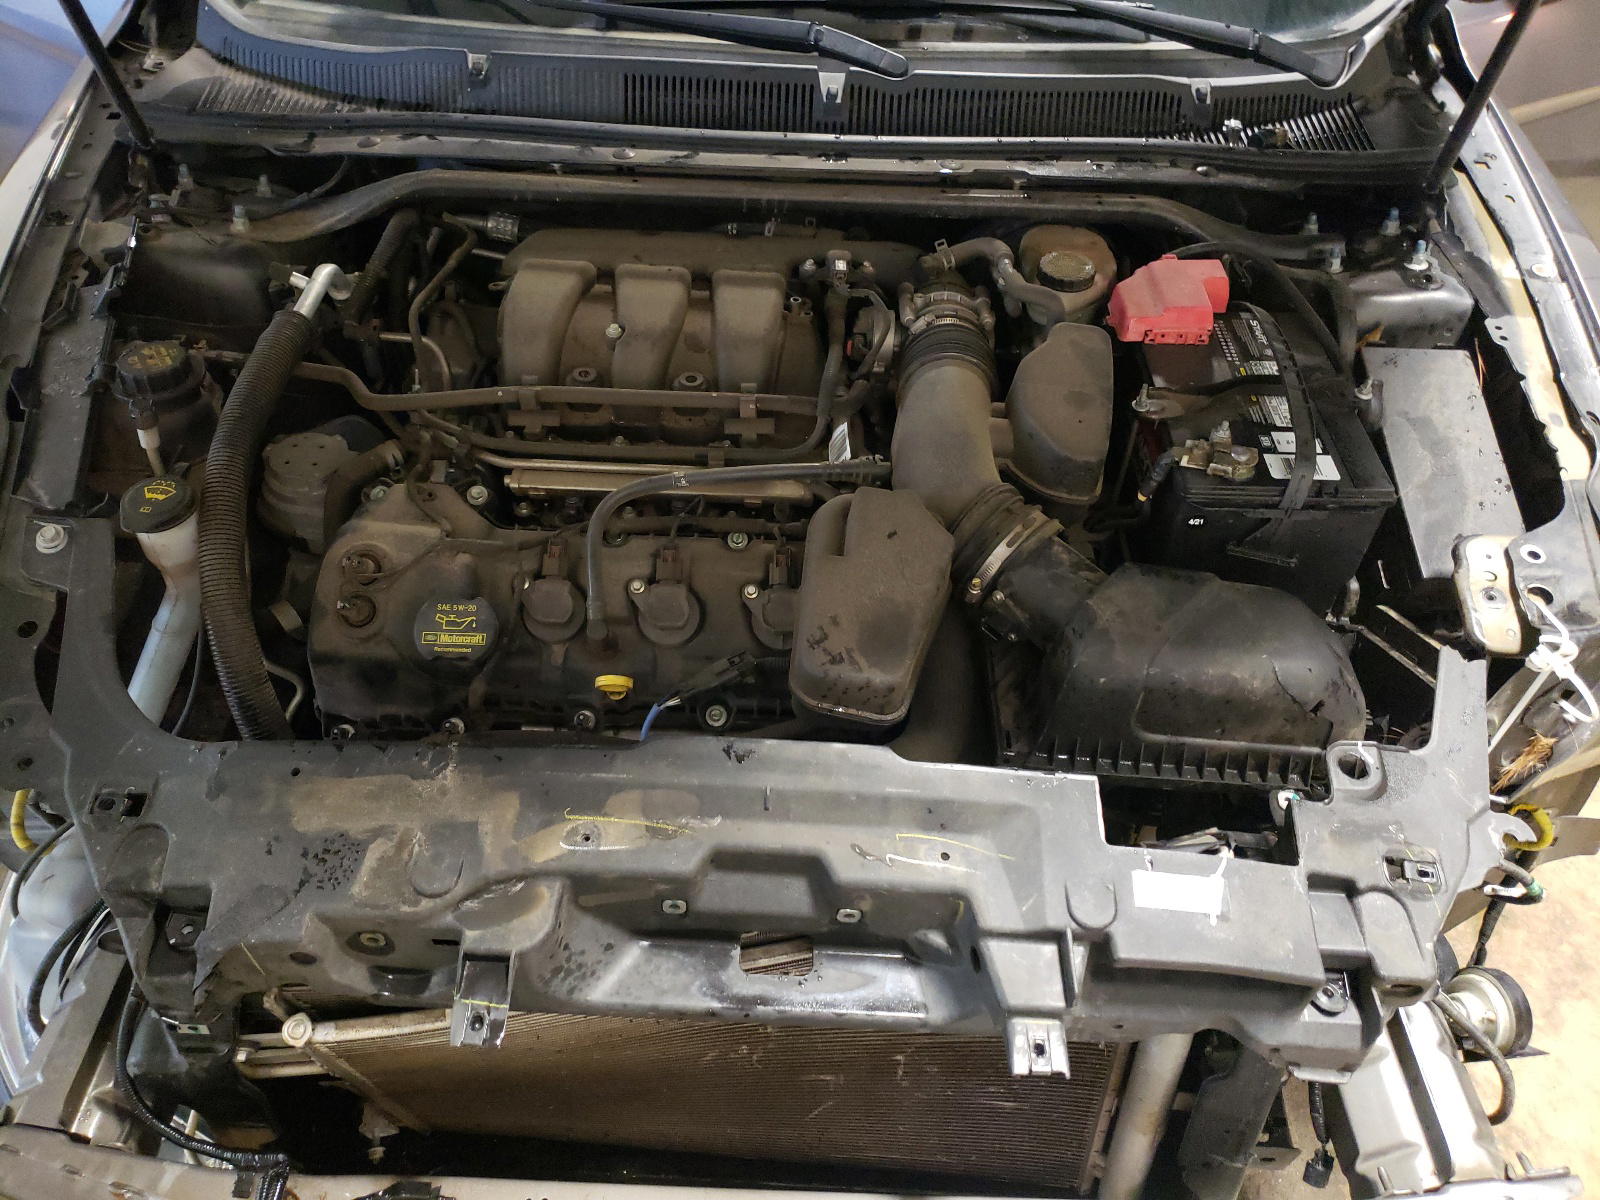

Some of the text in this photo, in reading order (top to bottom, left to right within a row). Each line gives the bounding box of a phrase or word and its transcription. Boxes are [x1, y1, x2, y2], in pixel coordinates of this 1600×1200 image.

[437, 603, 477, 612] SAE 5W-20
[440, 633, 483, 644] Motorcraft
